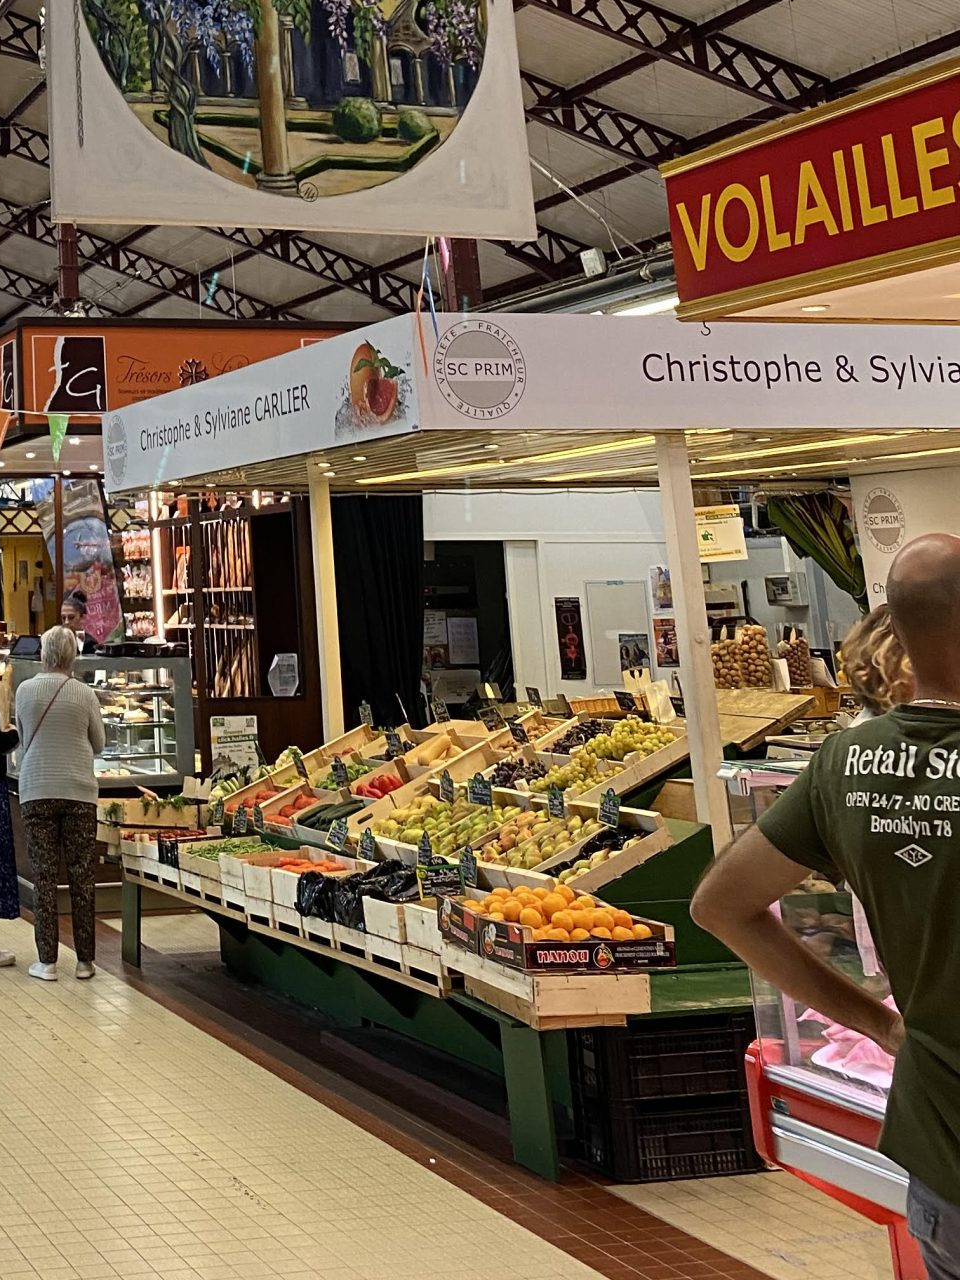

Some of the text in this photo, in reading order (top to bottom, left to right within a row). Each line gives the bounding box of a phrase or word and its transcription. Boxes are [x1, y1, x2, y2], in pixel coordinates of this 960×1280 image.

[435, 328, 458, 385] VARIETE
[478, 322, 525, 384] FRAICHEUR
[116, 355, 172, 384] Trésors
[447, 362, 513, 376] SC PRIM
[642, 352, 823, 390] Christophe
[835, 354, 860, 384] &
[140, 384, 311, 451] Christophe & Sylviane CARLIER
[456, 401, 511, 417] QUALITE
[868, 515, 899, 526] SC PRIM
[844, 741, 918, 778] Retail
[845, 791, 870, 807] OPEN
[871, 792, 904, 810] 24/7
[912, 795, 931, 811] NO
[870, 814, 953, 839] Brooklyn 78
